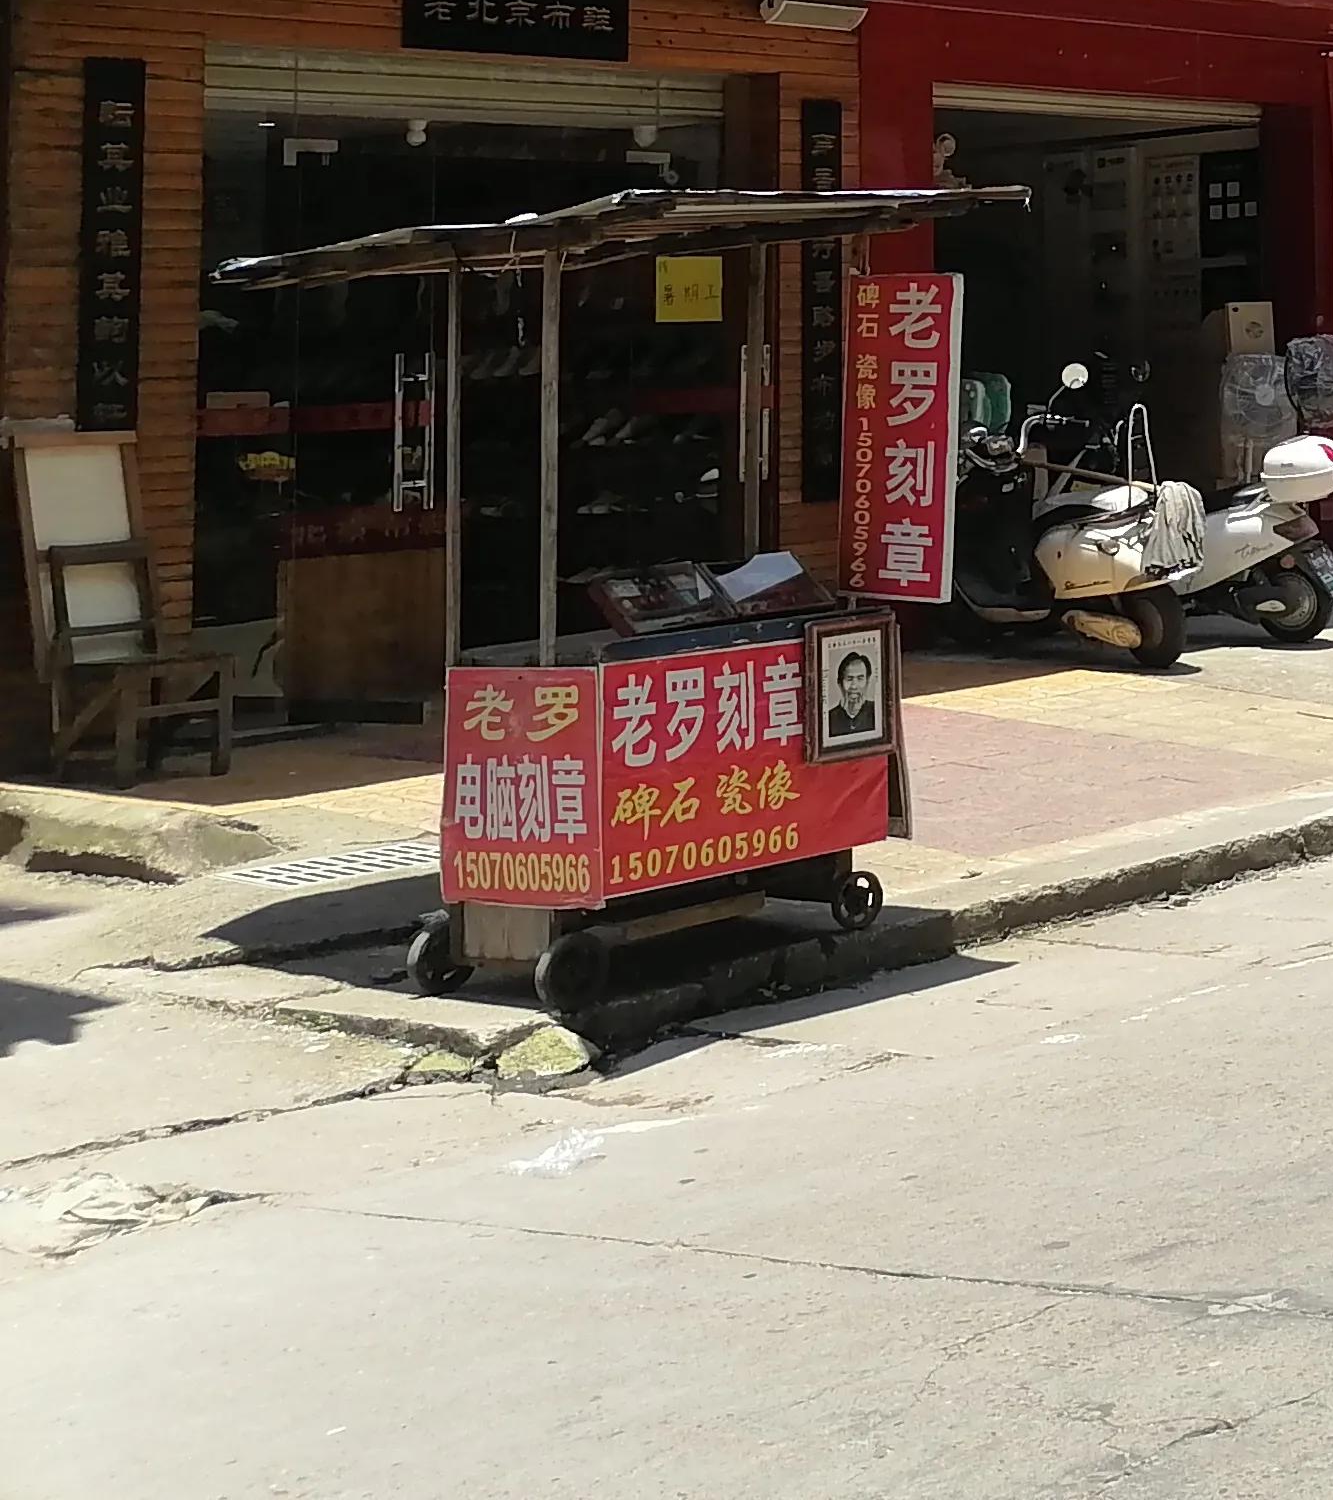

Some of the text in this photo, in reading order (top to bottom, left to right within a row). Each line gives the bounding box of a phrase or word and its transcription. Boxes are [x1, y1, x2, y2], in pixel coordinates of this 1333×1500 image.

[849, 283, 880, 589] 碑石 瓷像 15070605966
[878, 282, 942, 587] 老罗刻章
[463, 683, 579, 742] 老罗
[612, 654, 803, 768] 老罗刻章
[454, 753, 588, 844] 电脑刻章
[610, 759, 802, 841] 碑石 瓷像
[454, 850, 590, 894] 15070605966
[609, 822, 799, 885] 15070605966
